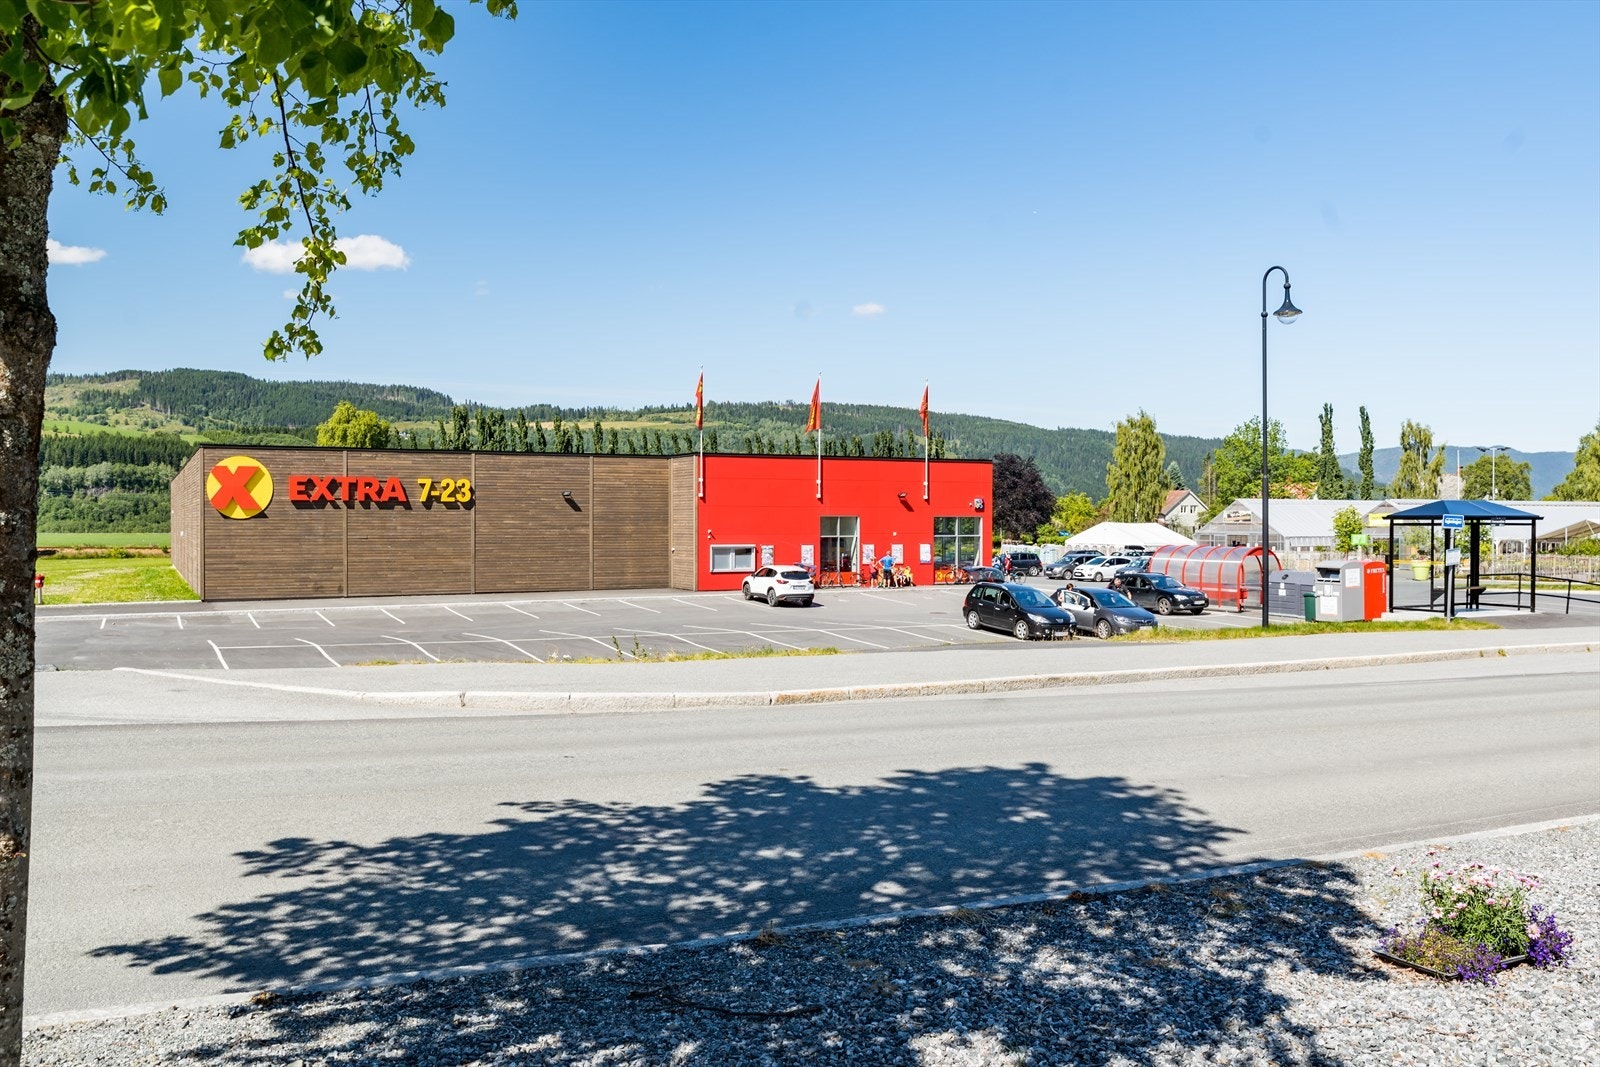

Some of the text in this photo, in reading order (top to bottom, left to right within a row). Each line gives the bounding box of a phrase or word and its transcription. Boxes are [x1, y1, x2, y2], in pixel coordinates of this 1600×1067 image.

[209, 465, 262, 511] X
[288, 475, 472, 503] EXTRA 7-23
